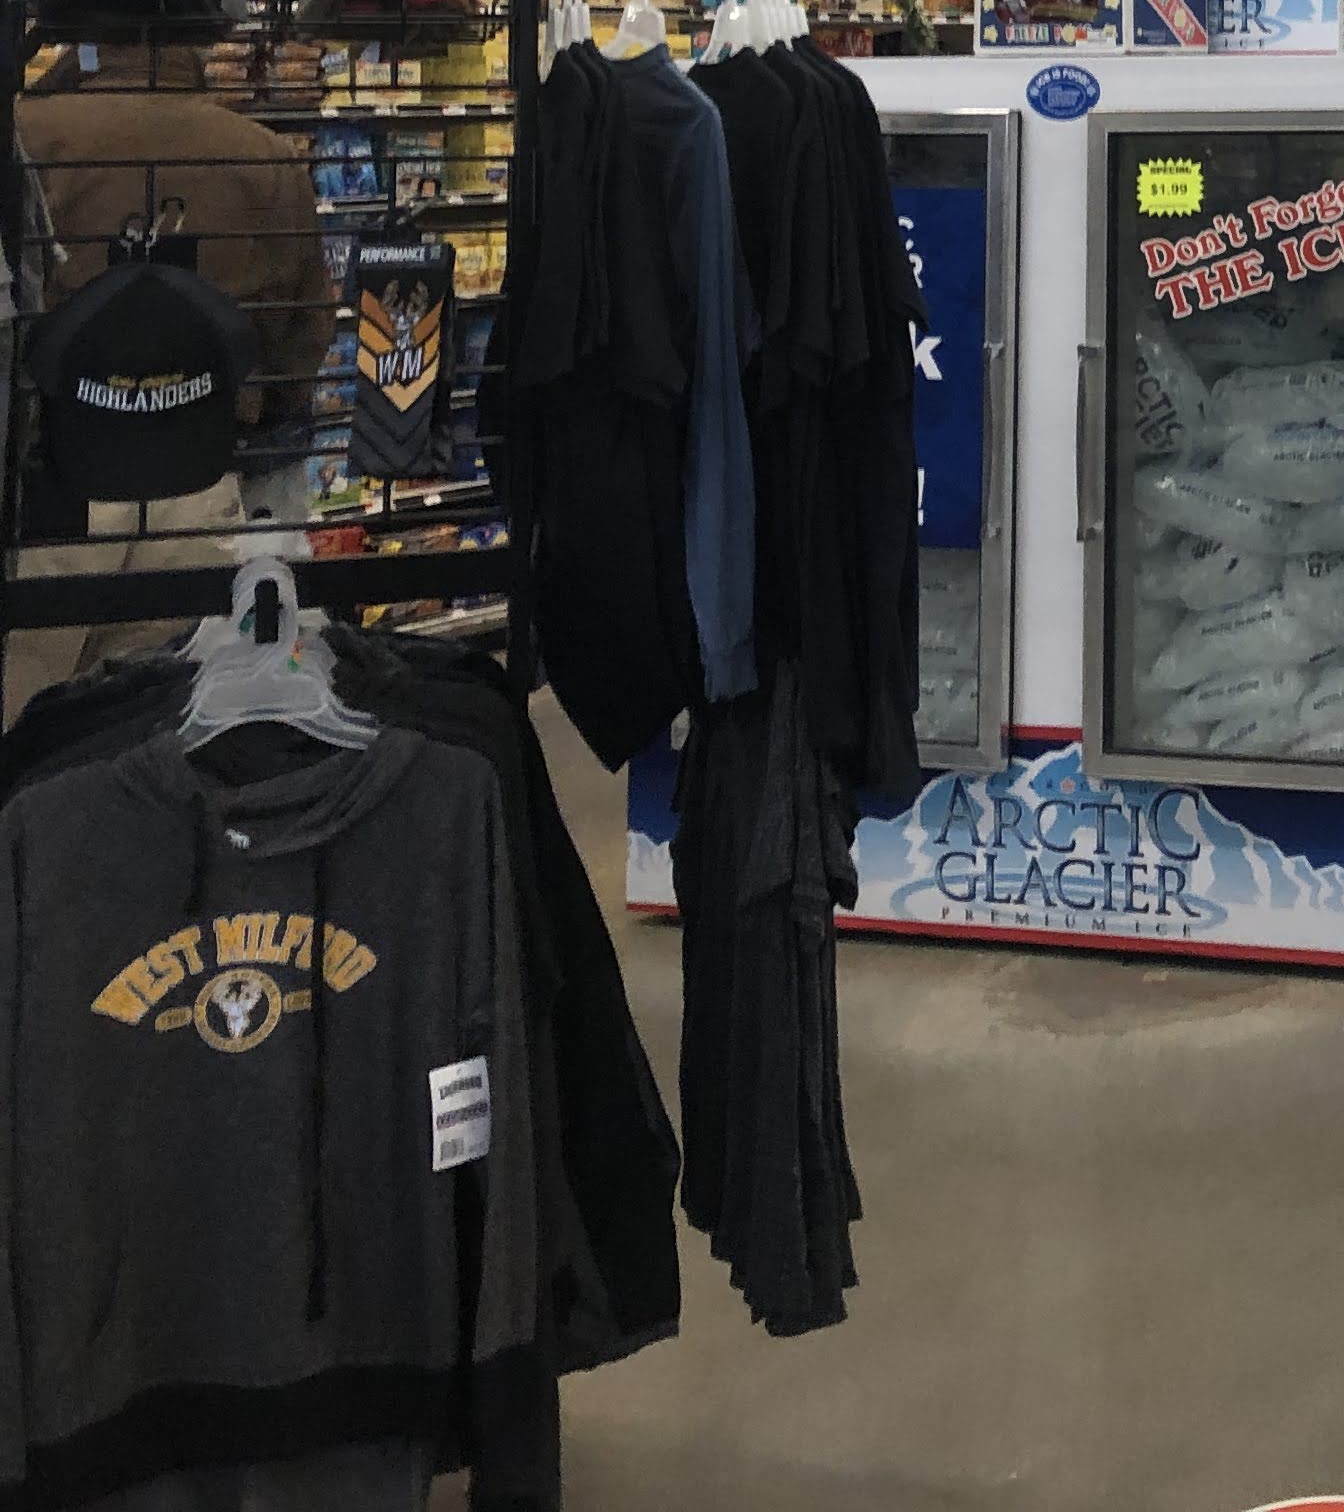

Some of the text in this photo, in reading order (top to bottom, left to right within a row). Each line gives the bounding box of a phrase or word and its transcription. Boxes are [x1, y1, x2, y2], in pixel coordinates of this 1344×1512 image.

[1150, 183, 1188, 196] $1.99
[360, 245, 426, 264] PERFORMANCE
[1140, 212, 1248, 278] Don't
[1155, 248, 1274, 319] THE
[76, 372, 213, 413] HIGHLANDERS
[933, 775, 1202, 861] ARCTIC
[934, 851, 1201, 918] GLACIER
[941, 906, 1191, 938] PREMIUM ICE
[90, 924, 205, 1026] WEST
